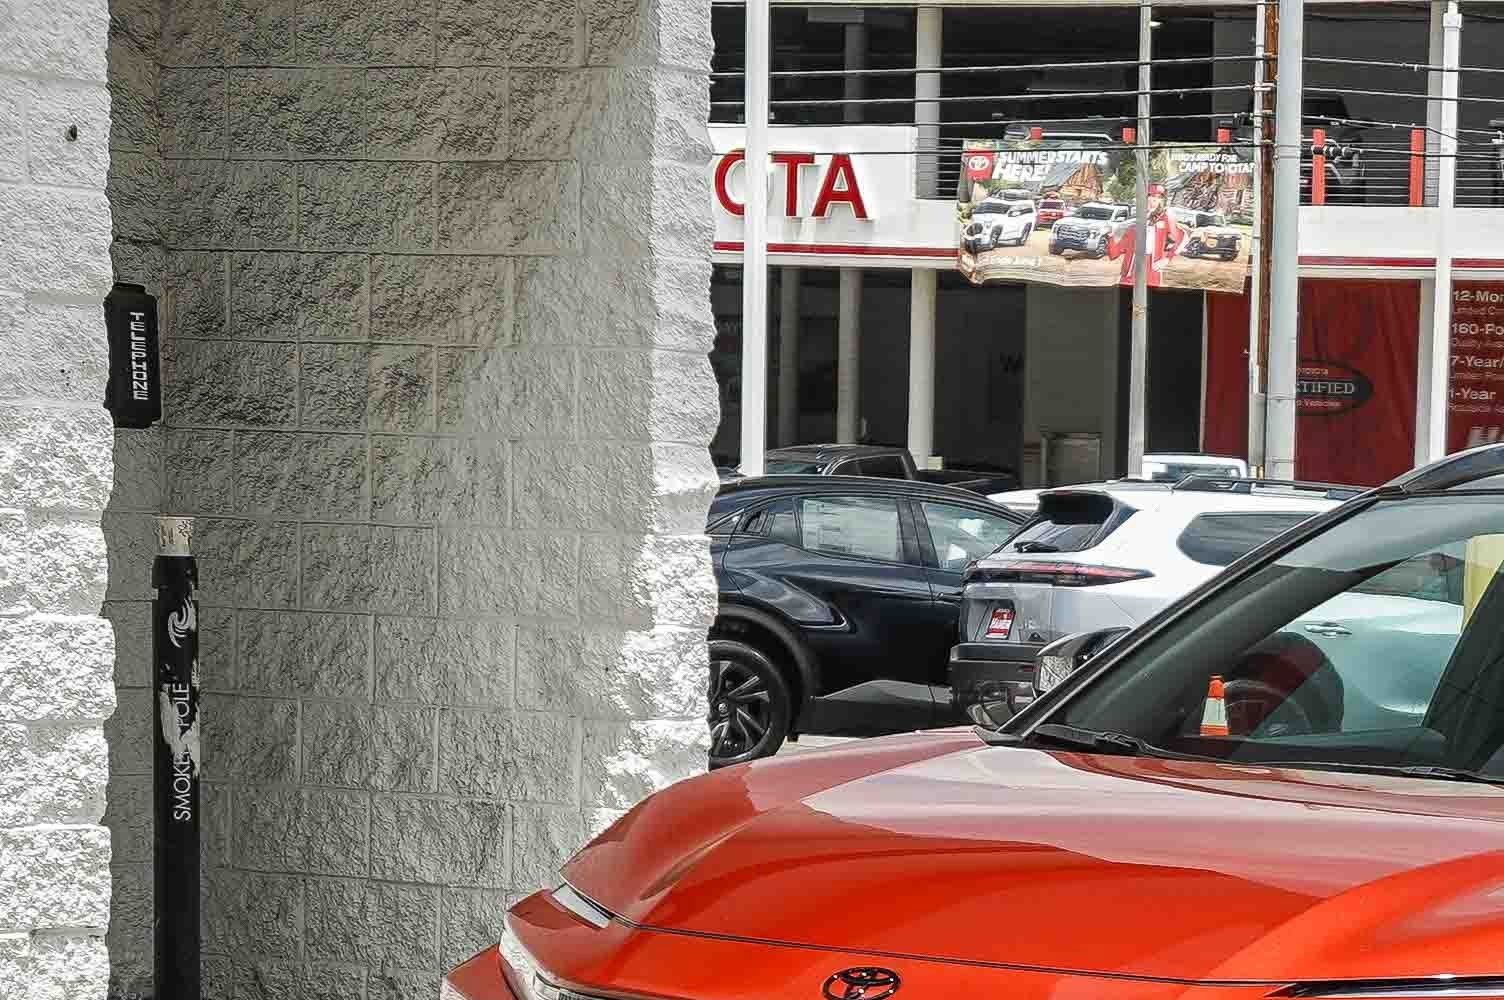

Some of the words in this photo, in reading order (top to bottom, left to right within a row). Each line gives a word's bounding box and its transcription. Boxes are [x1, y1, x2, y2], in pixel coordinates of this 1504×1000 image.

[130, 311, 149, 400] TELEPHONE
[172, 682, 192, 726] POLE
[172, 748, 192, 821] SMOKE
